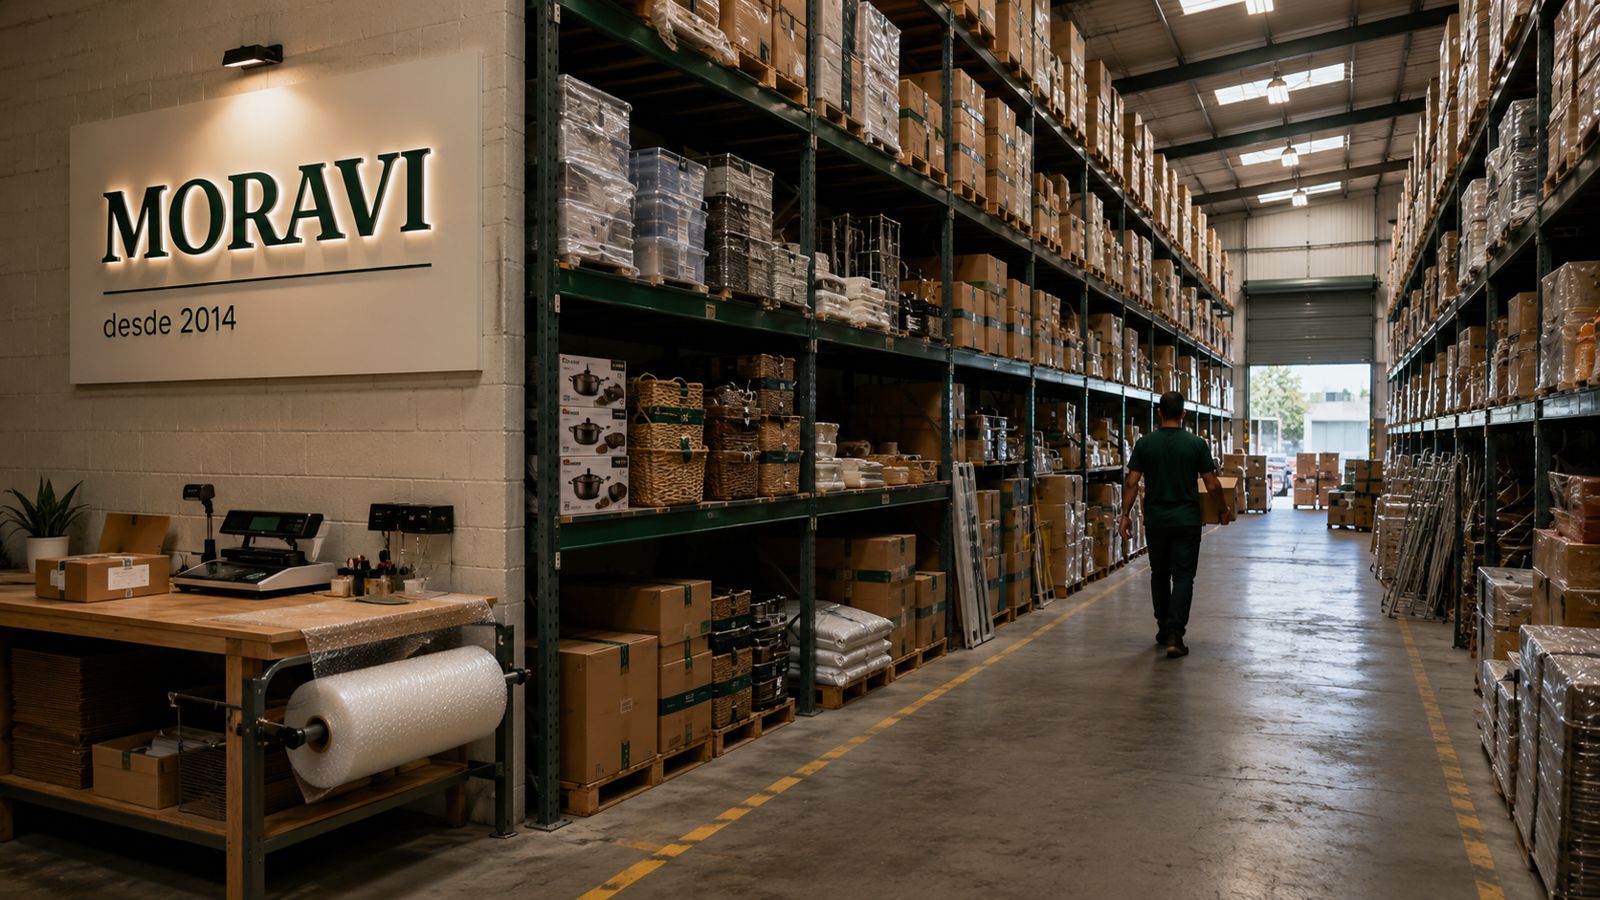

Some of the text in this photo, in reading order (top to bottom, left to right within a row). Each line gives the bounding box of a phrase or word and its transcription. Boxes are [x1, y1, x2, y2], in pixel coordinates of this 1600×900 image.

[102, 147, 432, 263] MORAVI
[103, 304, 237, 338] desde 2014
